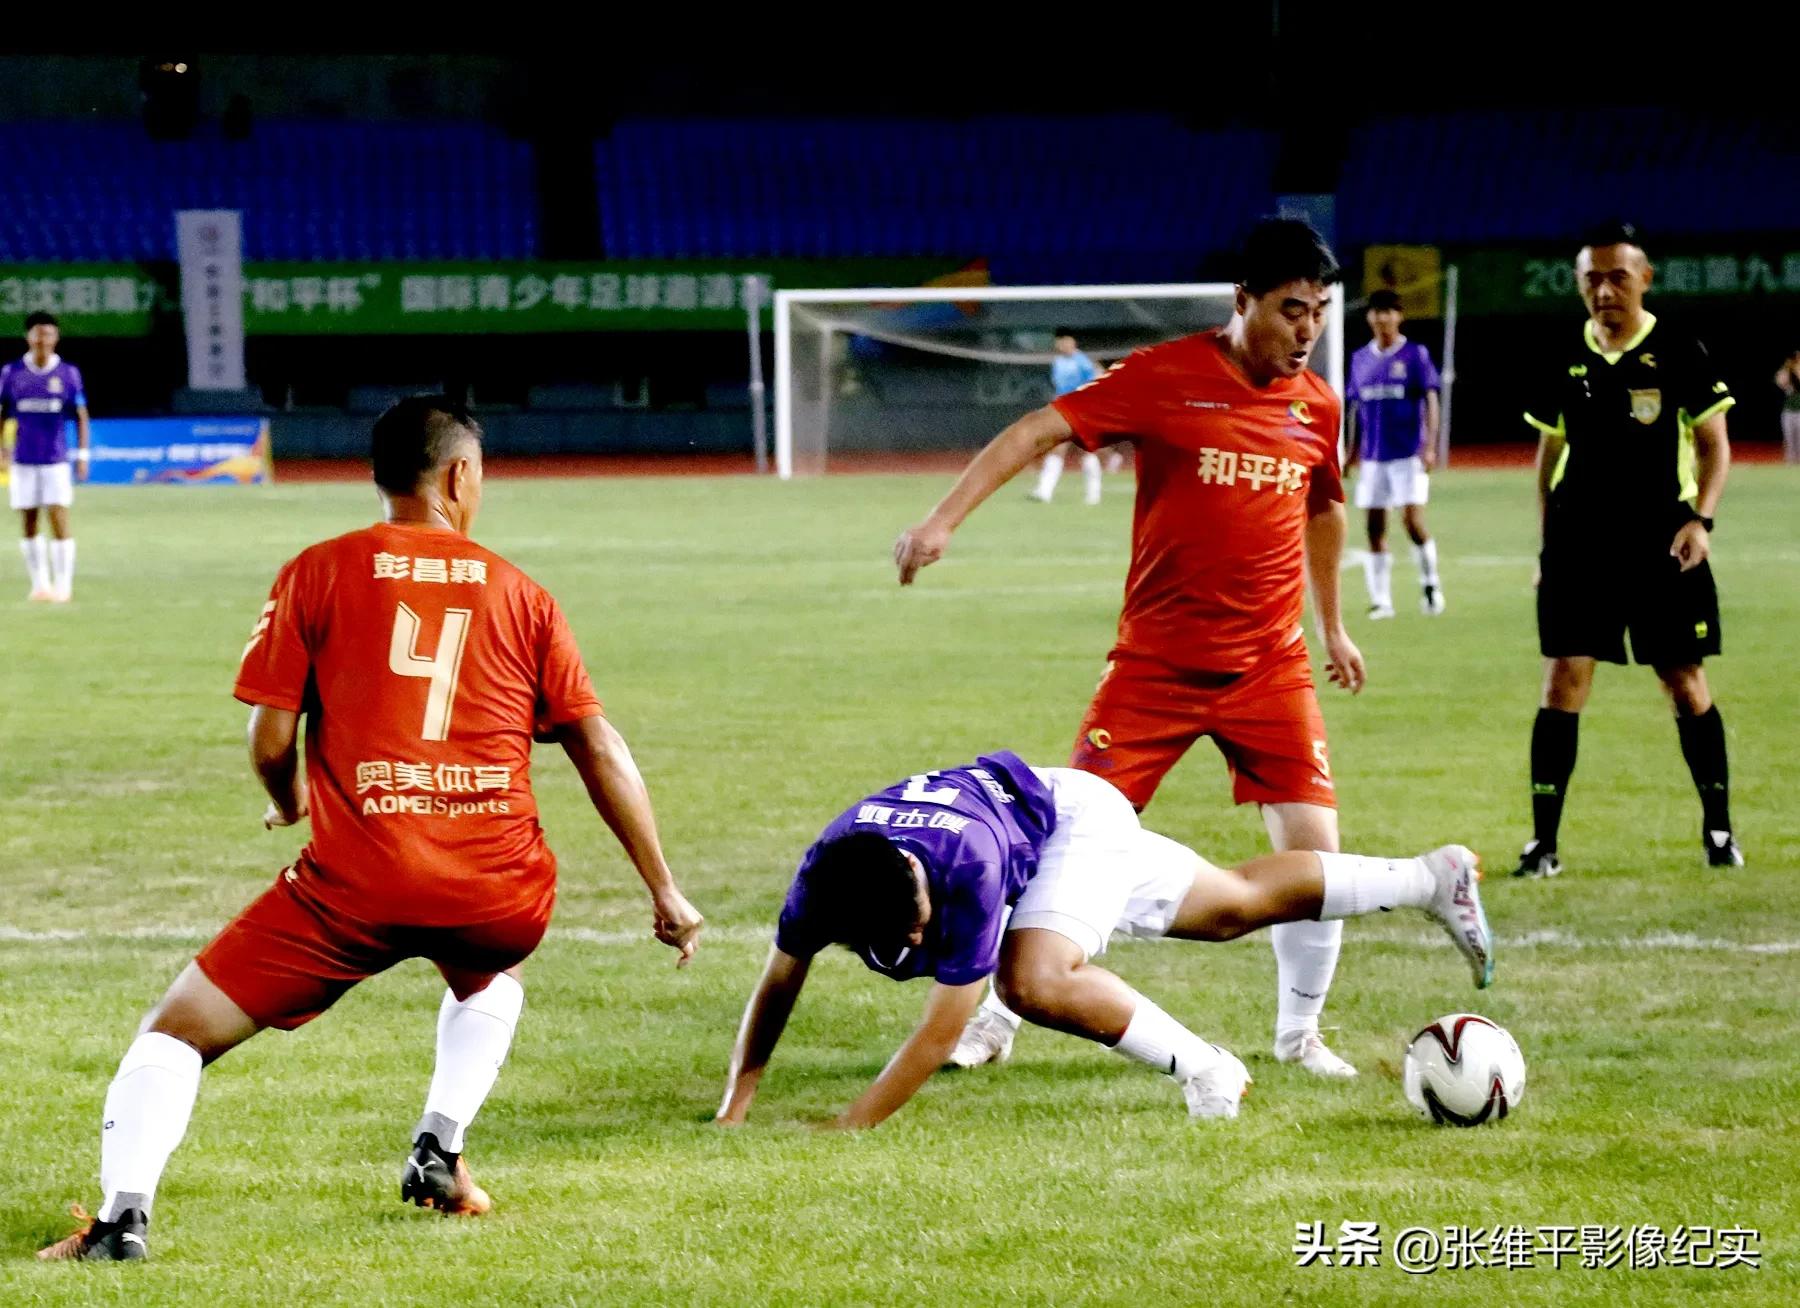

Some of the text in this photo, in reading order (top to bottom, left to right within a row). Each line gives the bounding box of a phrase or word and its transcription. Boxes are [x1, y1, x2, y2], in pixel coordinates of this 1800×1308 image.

[1198, 447, 1307, 496] 和平杯
[373, 552, 487, 585] 彭昌颖
[388, 601, 472, 741] 4
[356, 760, 511, 793] 奥美体育
[1312, 740, 1330, 777] 5
